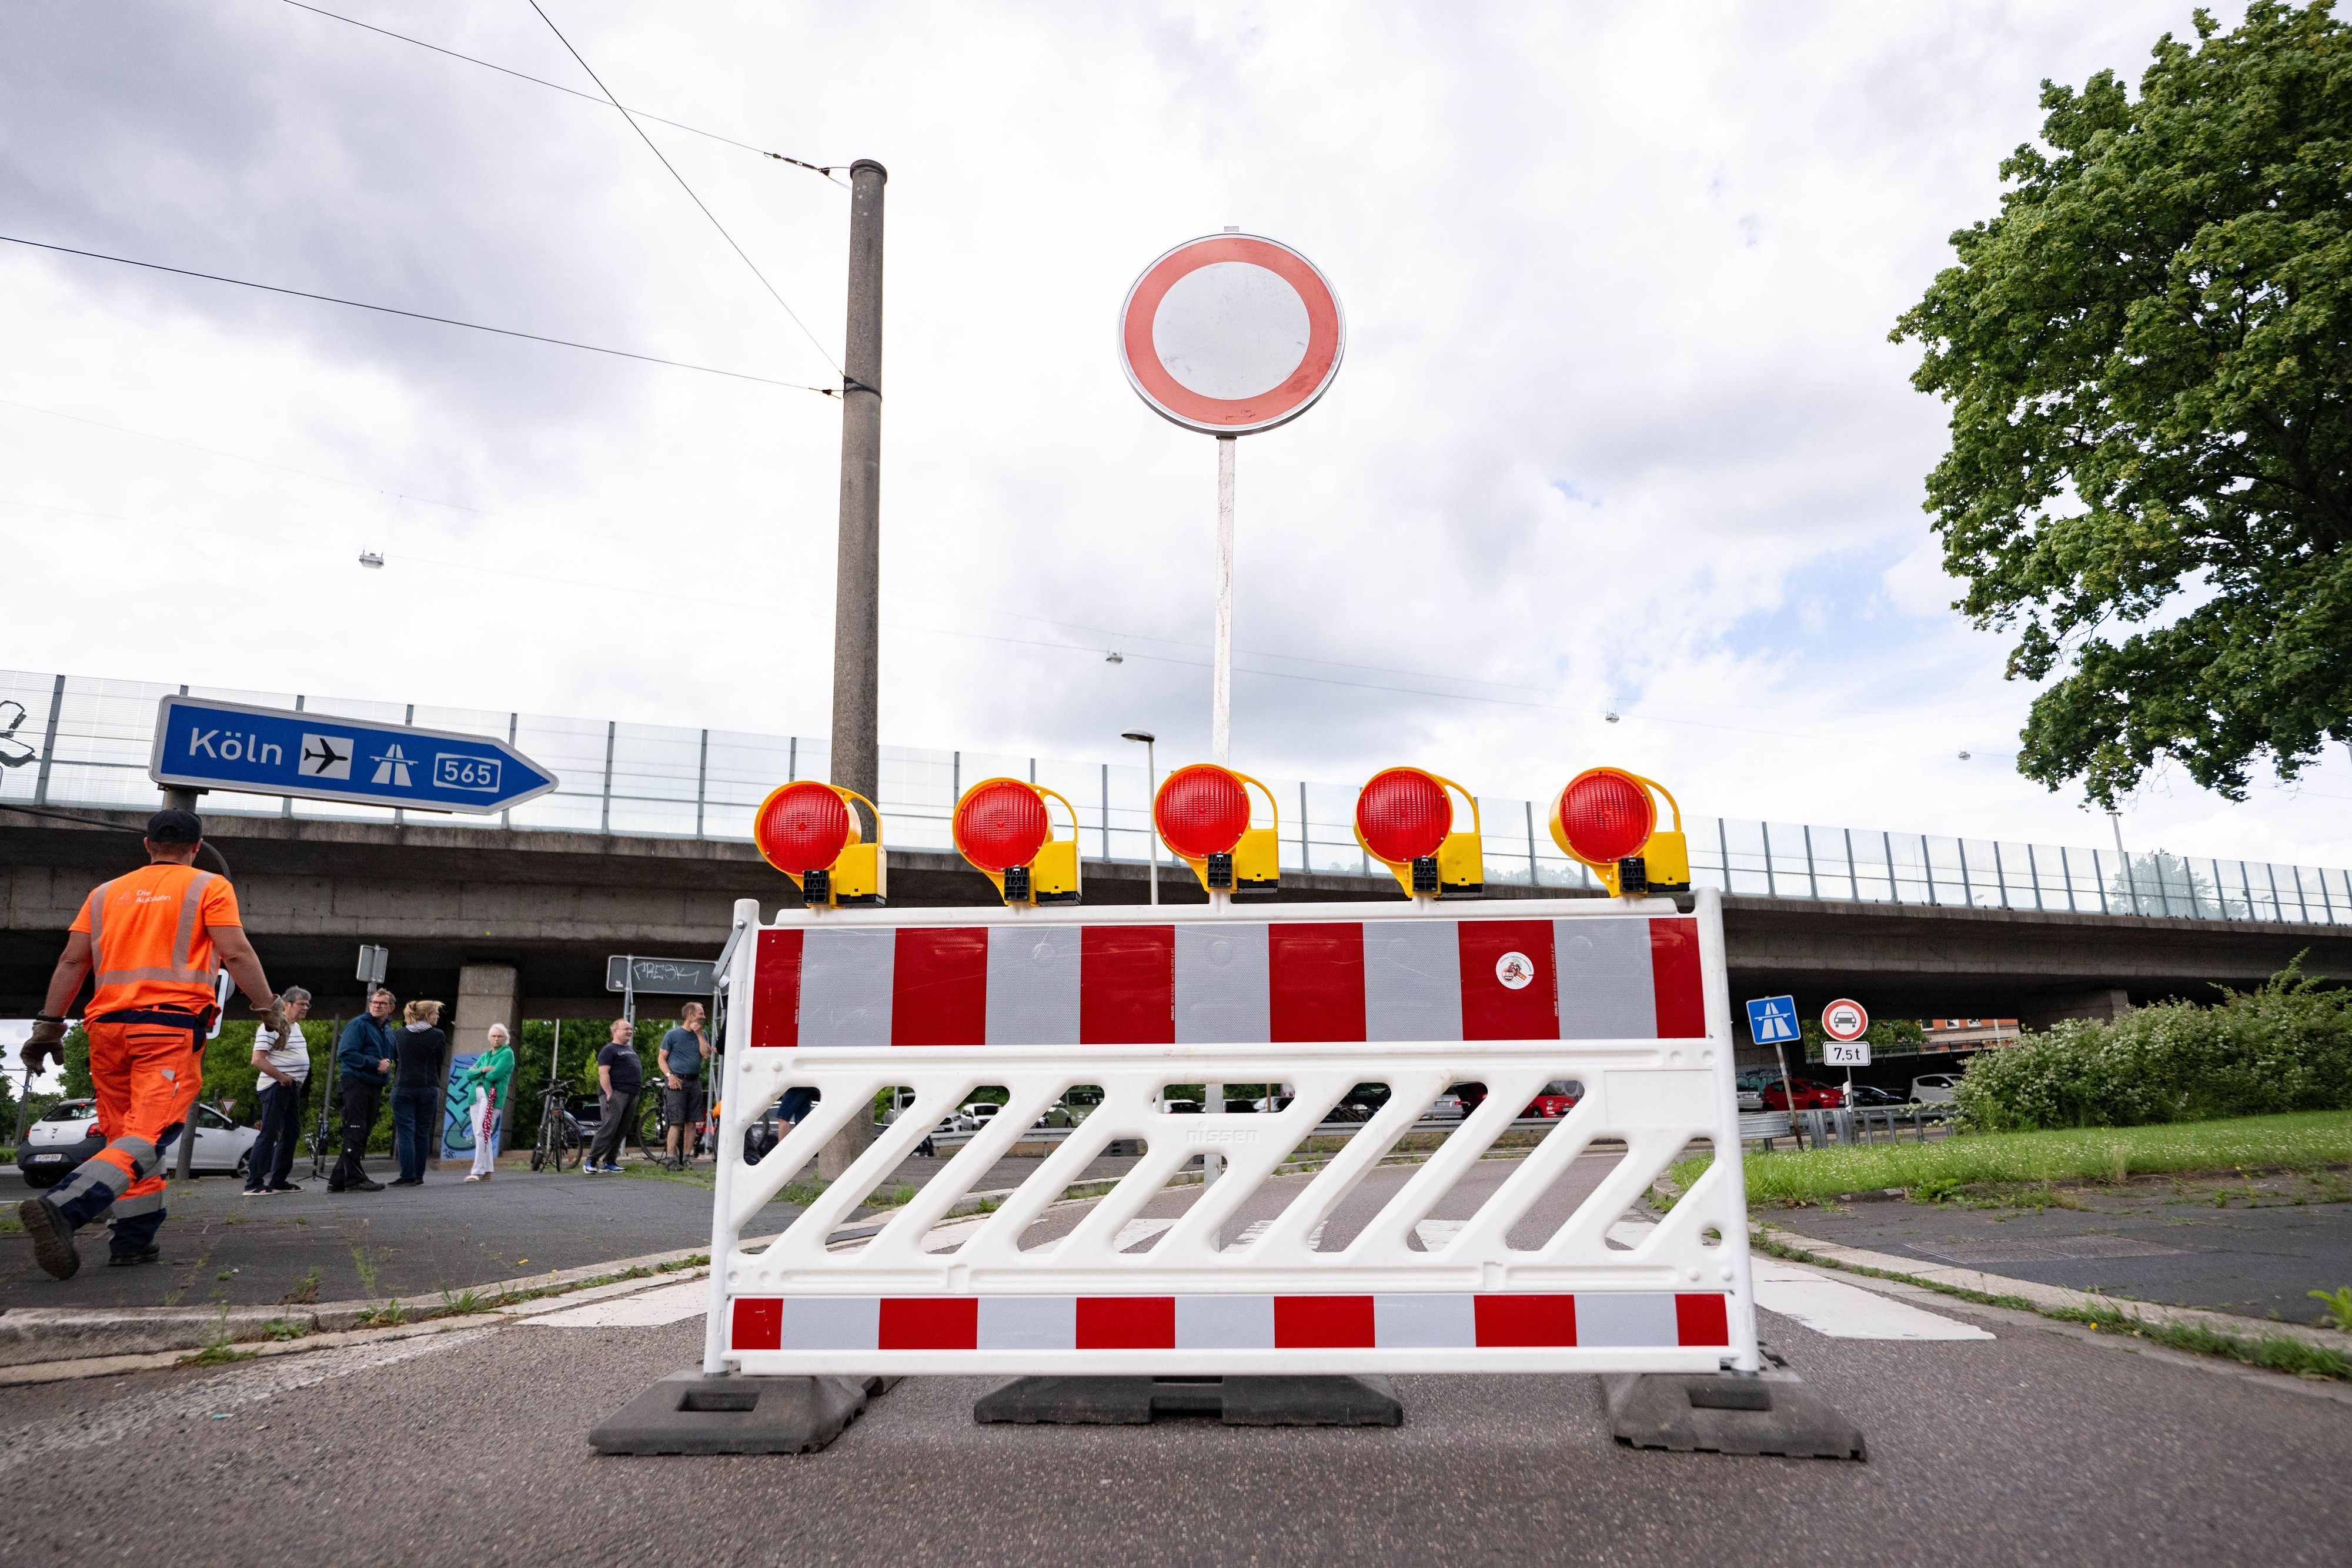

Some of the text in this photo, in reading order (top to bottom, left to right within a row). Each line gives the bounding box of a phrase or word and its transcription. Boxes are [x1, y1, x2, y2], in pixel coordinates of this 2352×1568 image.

[188, 727, 491, 785] Köln 565
[135, 895, 171, 903] Auobahn
[1834, 1047, 1860, 1061] 7,5 t
[1187, 1121, 1258, 1143] nissen
